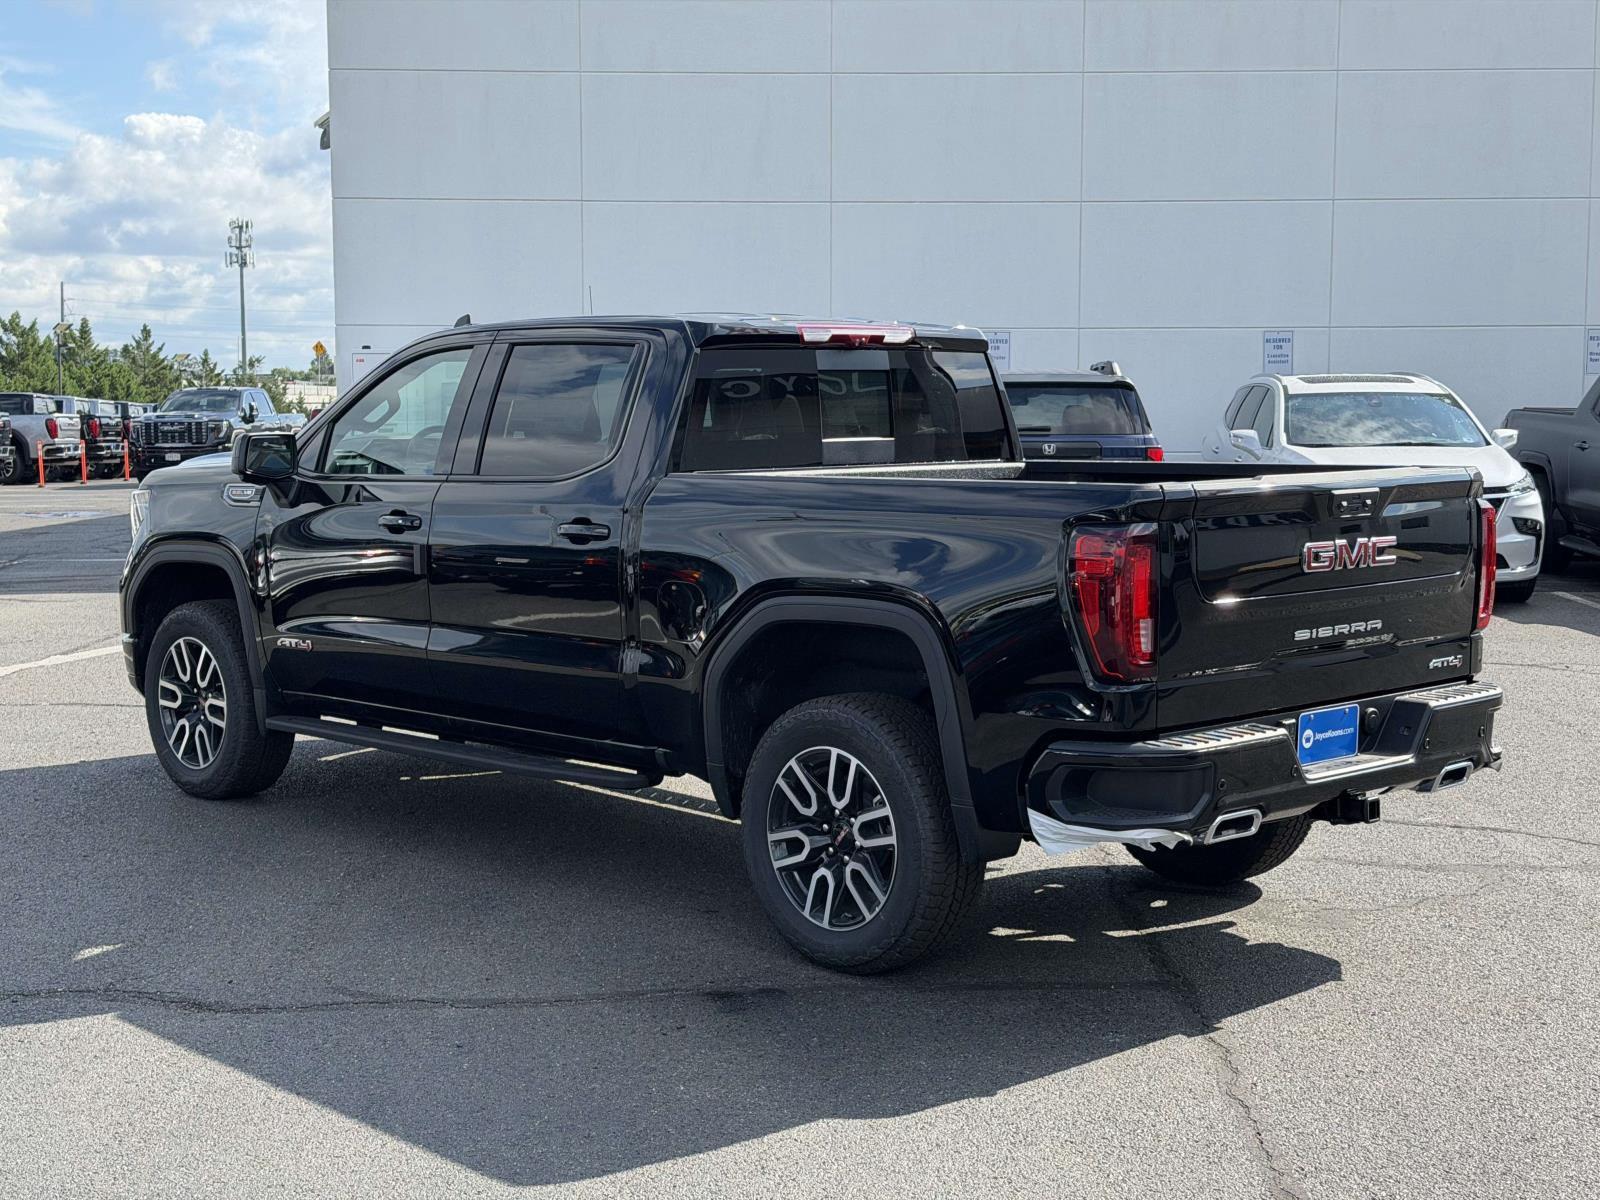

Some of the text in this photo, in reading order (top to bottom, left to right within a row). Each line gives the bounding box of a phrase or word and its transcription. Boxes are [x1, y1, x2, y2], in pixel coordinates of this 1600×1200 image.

[1303, 536, 1397, 573] GMC
[1293, 619, 1383, 641] SIERRA
[277, 637, 312, 652] AT4
[1428, 654, 1463, 670] AT4
[1314, 727, 1355, 741] JoyceKoons.com
